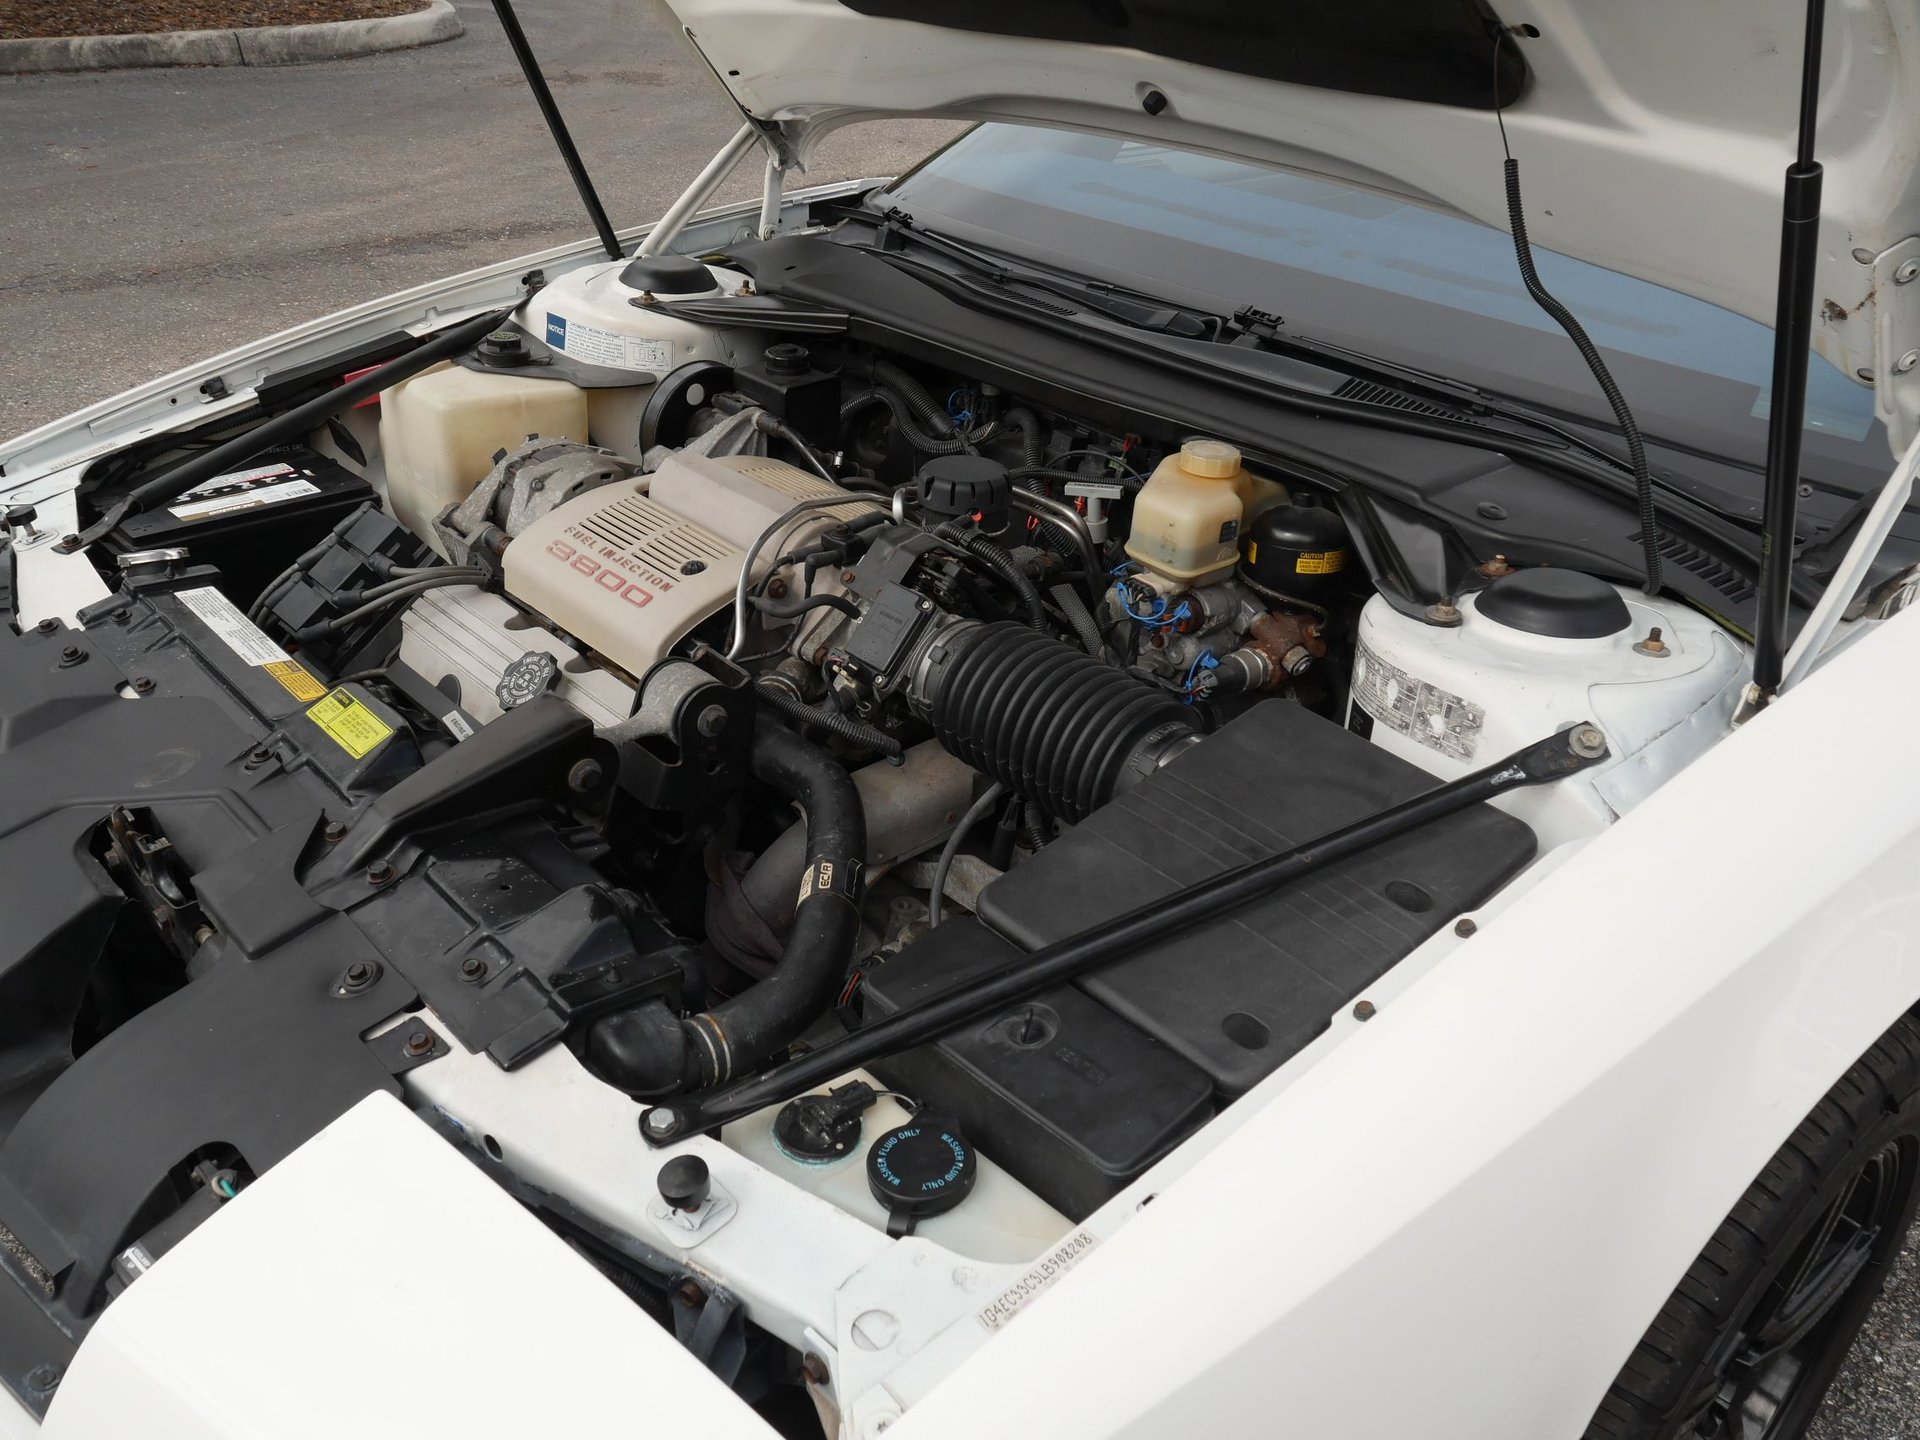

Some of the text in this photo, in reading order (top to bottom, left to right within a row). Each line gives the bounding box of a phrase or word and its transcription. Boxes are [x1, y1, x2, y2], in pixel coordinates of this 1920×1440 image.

[548, 323, 565, 336] NOTICE
[545, 540, 654, 608] 3800
[564, 526, 673, 592] FUEL INJECTION
[877, 1128, 921, 1186] WASHER FLUID ONLY
[921, 1133, 965, 1191] WASHER FLUID ONLY
[978, 1232, 1093, 1328] 1G4EC33C3LB908208
